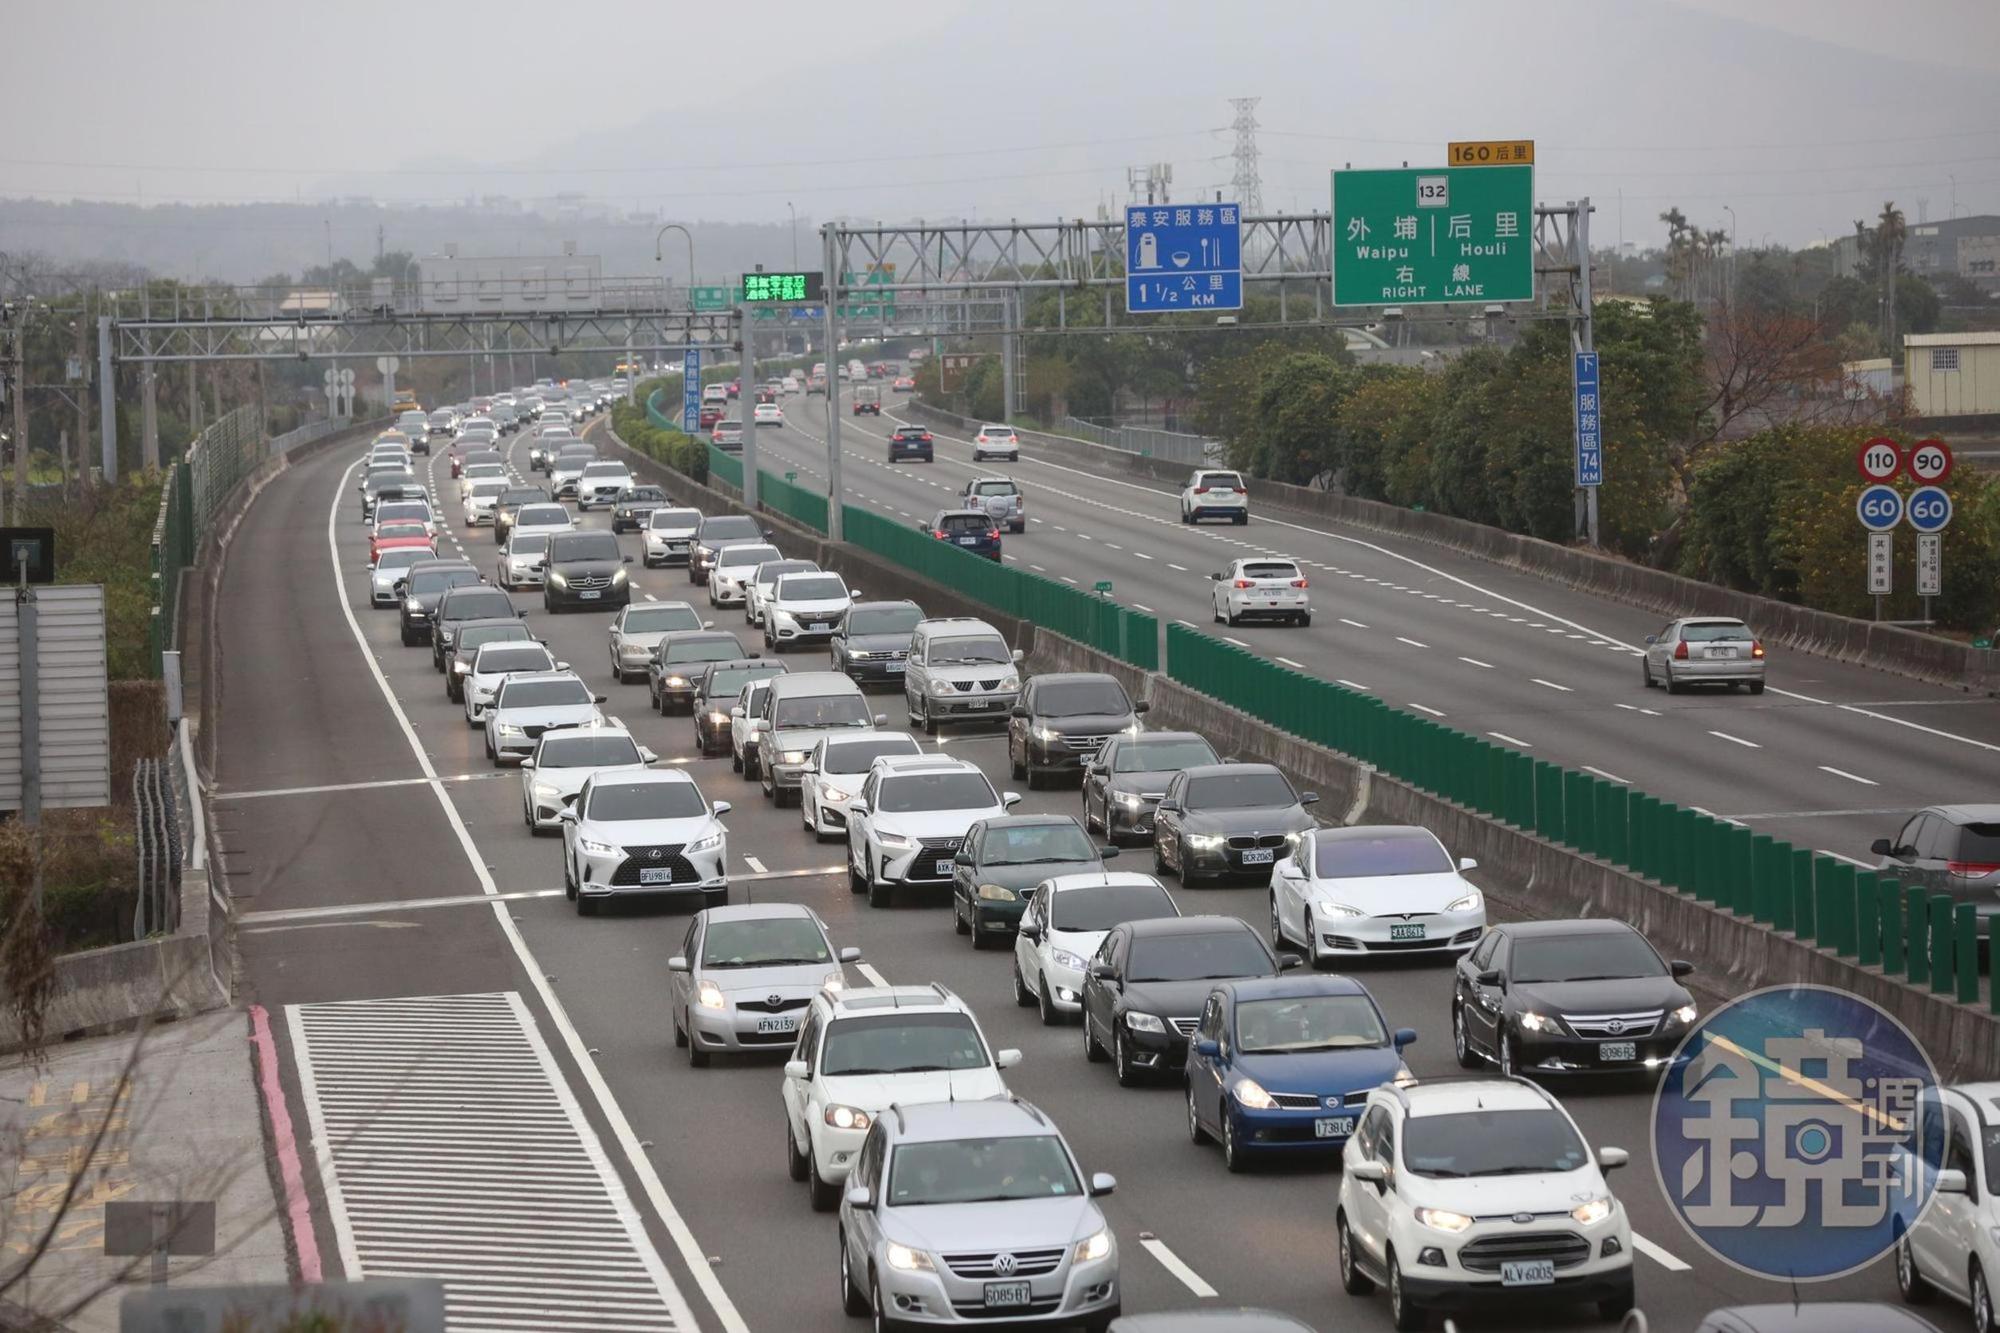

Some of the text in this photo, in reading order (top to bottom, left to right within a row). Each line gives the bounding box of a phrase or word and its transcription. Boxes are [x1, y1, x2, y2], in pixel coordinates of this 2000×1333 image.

[1455, 145, 1527, 161] 160 后里
[1419, 185, 1446, 198] 132
[1130, 207, 1237, 228] 泰安服務區
[1448, 212, 1519, 238] 后里
[1347, 215, 1418, 241] 外埔
[1356, 246, 1409, 260] Waipu
[1461, 242, 1507, 256] Houli
[1396, 263, 1471, 283] 右線
[1182, 274, 1223, 291] 公里
[1382, 284, 1484, 298] RIGHT LANE
[1191, 294, 1215, 305] KM
[1578, 354, 1598, 450] 下一服務區
[1581, 452, 1598, 470] 74
[1867, 453, 1894, 469] 110
[1917, 454, 1943, 470] 90
[1582, 471, 1599, 482] KM
[1864, 499, 1896, 517] 60
[1913, 500, 1945, 519] 60
